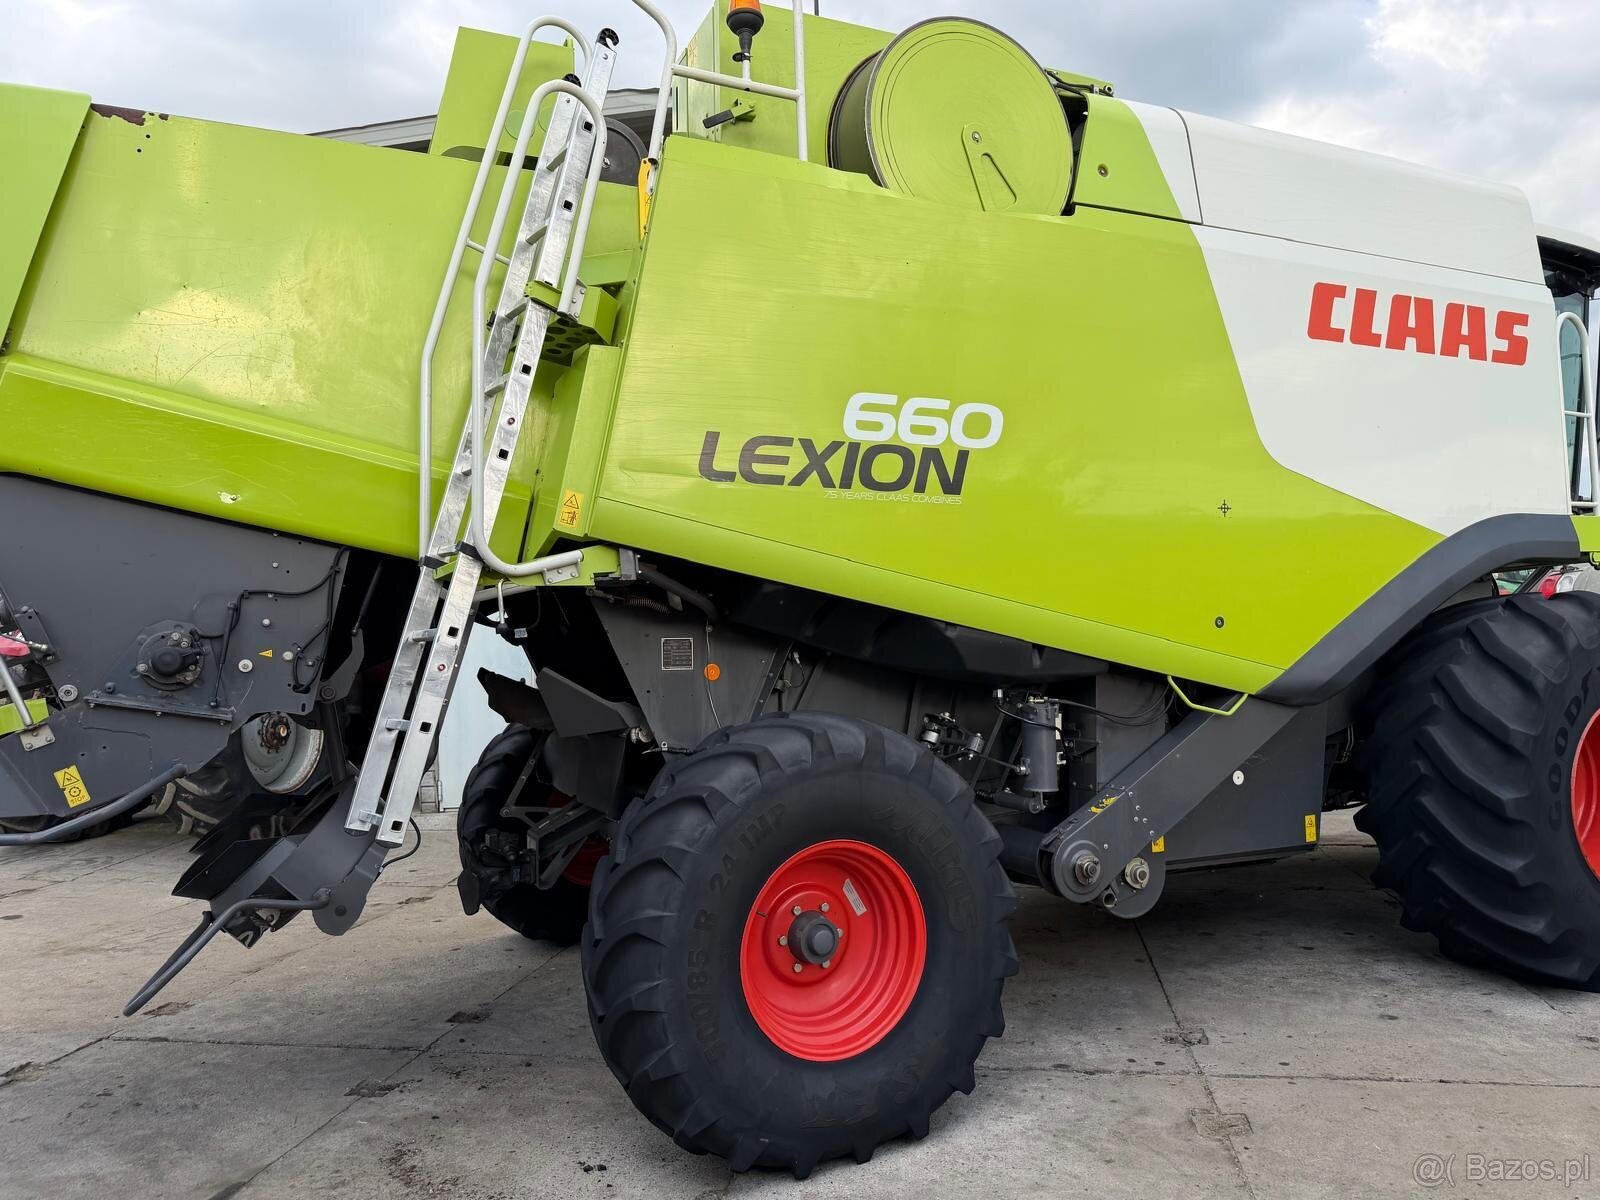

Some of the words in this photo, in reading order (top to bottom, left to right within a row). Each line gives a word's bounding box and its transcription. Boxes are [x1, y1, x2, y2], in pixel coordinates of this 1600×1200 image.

[1308, 282, 1529, 366] CLAAS
[843, 392, 1003, 448] 660
[699, 431, 969, 495] LEXION
[841, 491, 874, 500] YEARS
[877, 493, 910, 502] CLAAS
[912, 494, 962, 505] COMBINES
